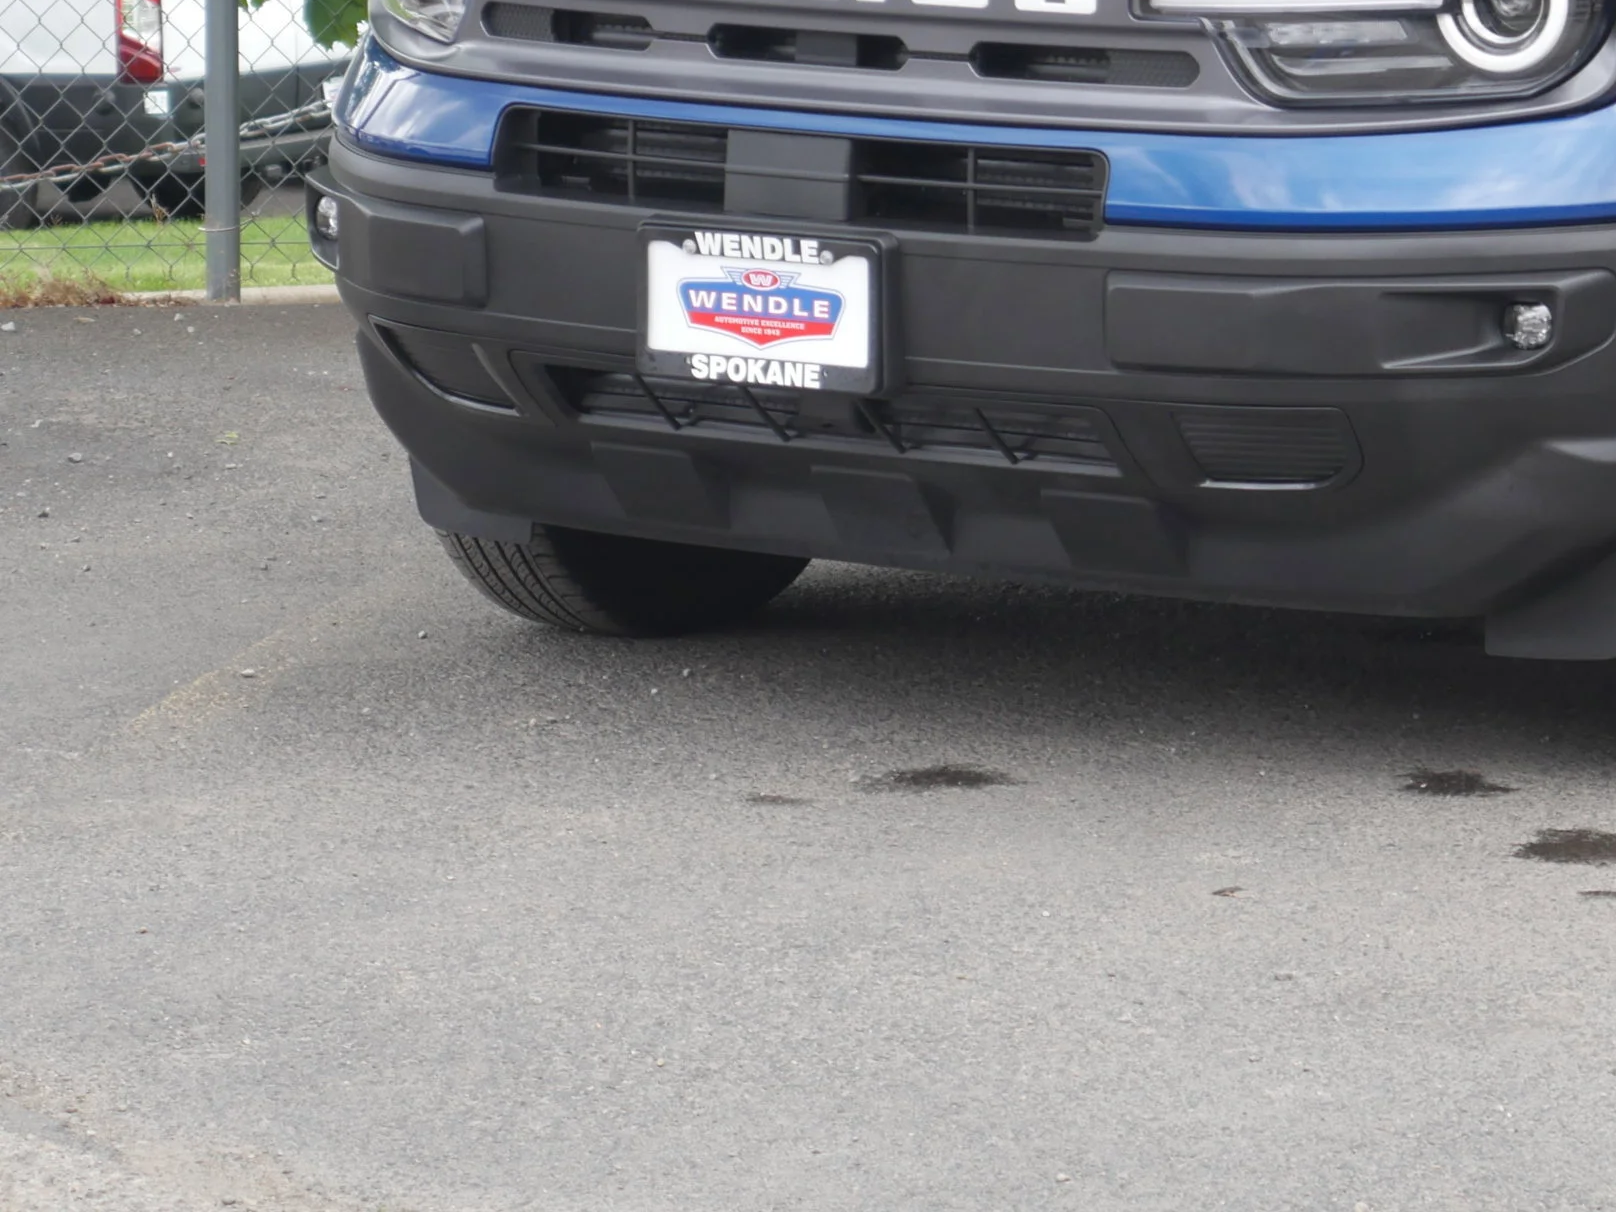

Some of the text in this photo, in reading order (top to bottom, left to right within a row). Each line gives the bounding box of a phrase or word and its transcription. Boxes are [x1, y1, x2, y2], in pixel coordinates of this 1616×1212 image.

[694, 231, 820, 264] WENDLE
[688, 289, 830, 318] WENDLE
[714, 315, 806, 330] AUTOMOTIVE EXCELLENCE
[741, 326, 763, 335] SINCE
[690, 353, 822, 389] SPOKANE
